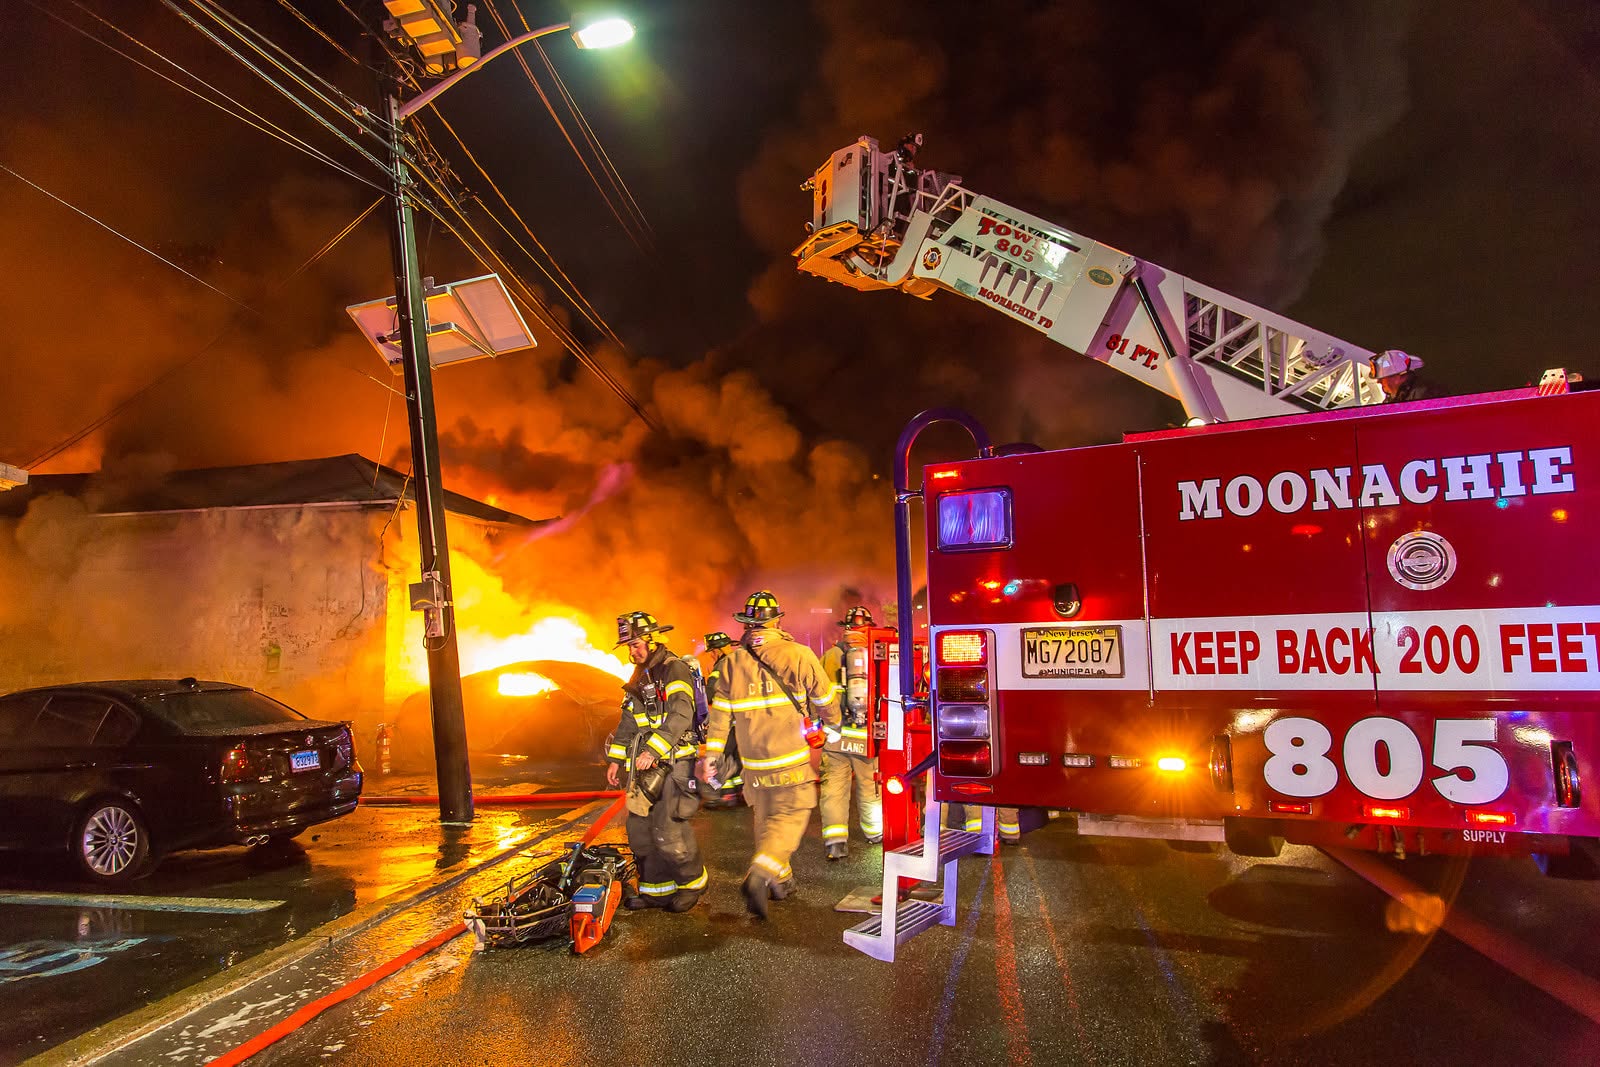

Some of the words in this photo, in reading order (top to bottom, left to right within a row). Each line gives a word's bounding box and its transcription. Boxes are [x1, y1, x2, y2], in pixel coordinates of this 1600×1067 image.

[996, 238, 1035, 263] 805
[978, 286, 1037, 321] MOONACHIE
[1037, 315, 1053, 329] FD
[1106, 334, 1129, 355] 81
[1129, 344, 1159, 370] FT.
[1177, 446, 1575, 521] MOONACHIE
[1046, 630, 1066, 638] New
[1067, 630, 1095, 639] Jersey
[1170, 630, 1260, 675] KEEP
[1276, 627, 1381, 675] BACK
[1397, 624, 1480, 675] 200
[1499, 622, 1600, 673] FEET
[1027, 639, 1115, 664] MG72087
[841, 741, 865, 754] LANG
[1263, 716, 1510, 805] 805
[1463, 829, 1506, 844] SUPPLY
